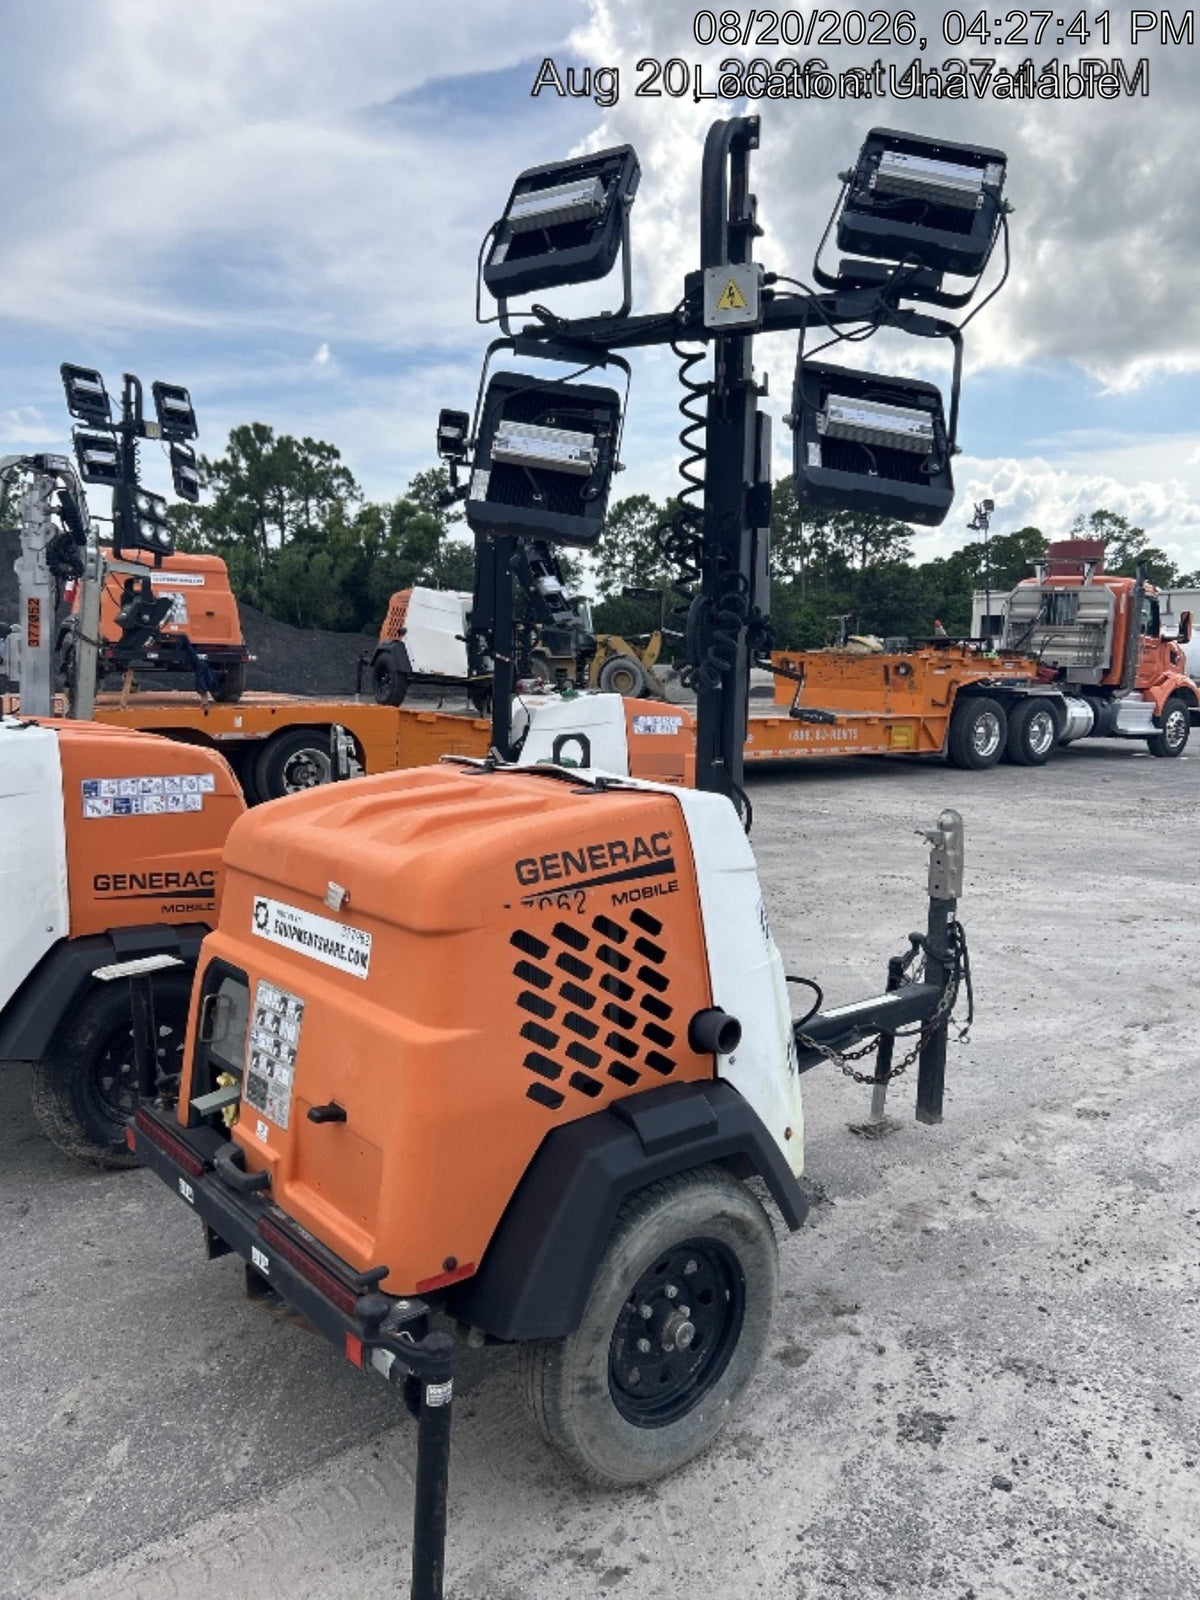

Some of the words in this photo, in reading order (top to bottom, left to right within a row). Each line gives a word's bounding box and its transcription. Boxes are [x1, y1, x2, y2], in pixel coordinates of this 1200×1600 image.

[515, 831, 672, 886] GENERAC
[93, 870, 215, 891] GENERAC
[611, 880, 680, 907] MOBILE
[161, 902, 215, 913] MOBILE
[274, 919, 369, 969] EQUIPMENTSHARE.COM
